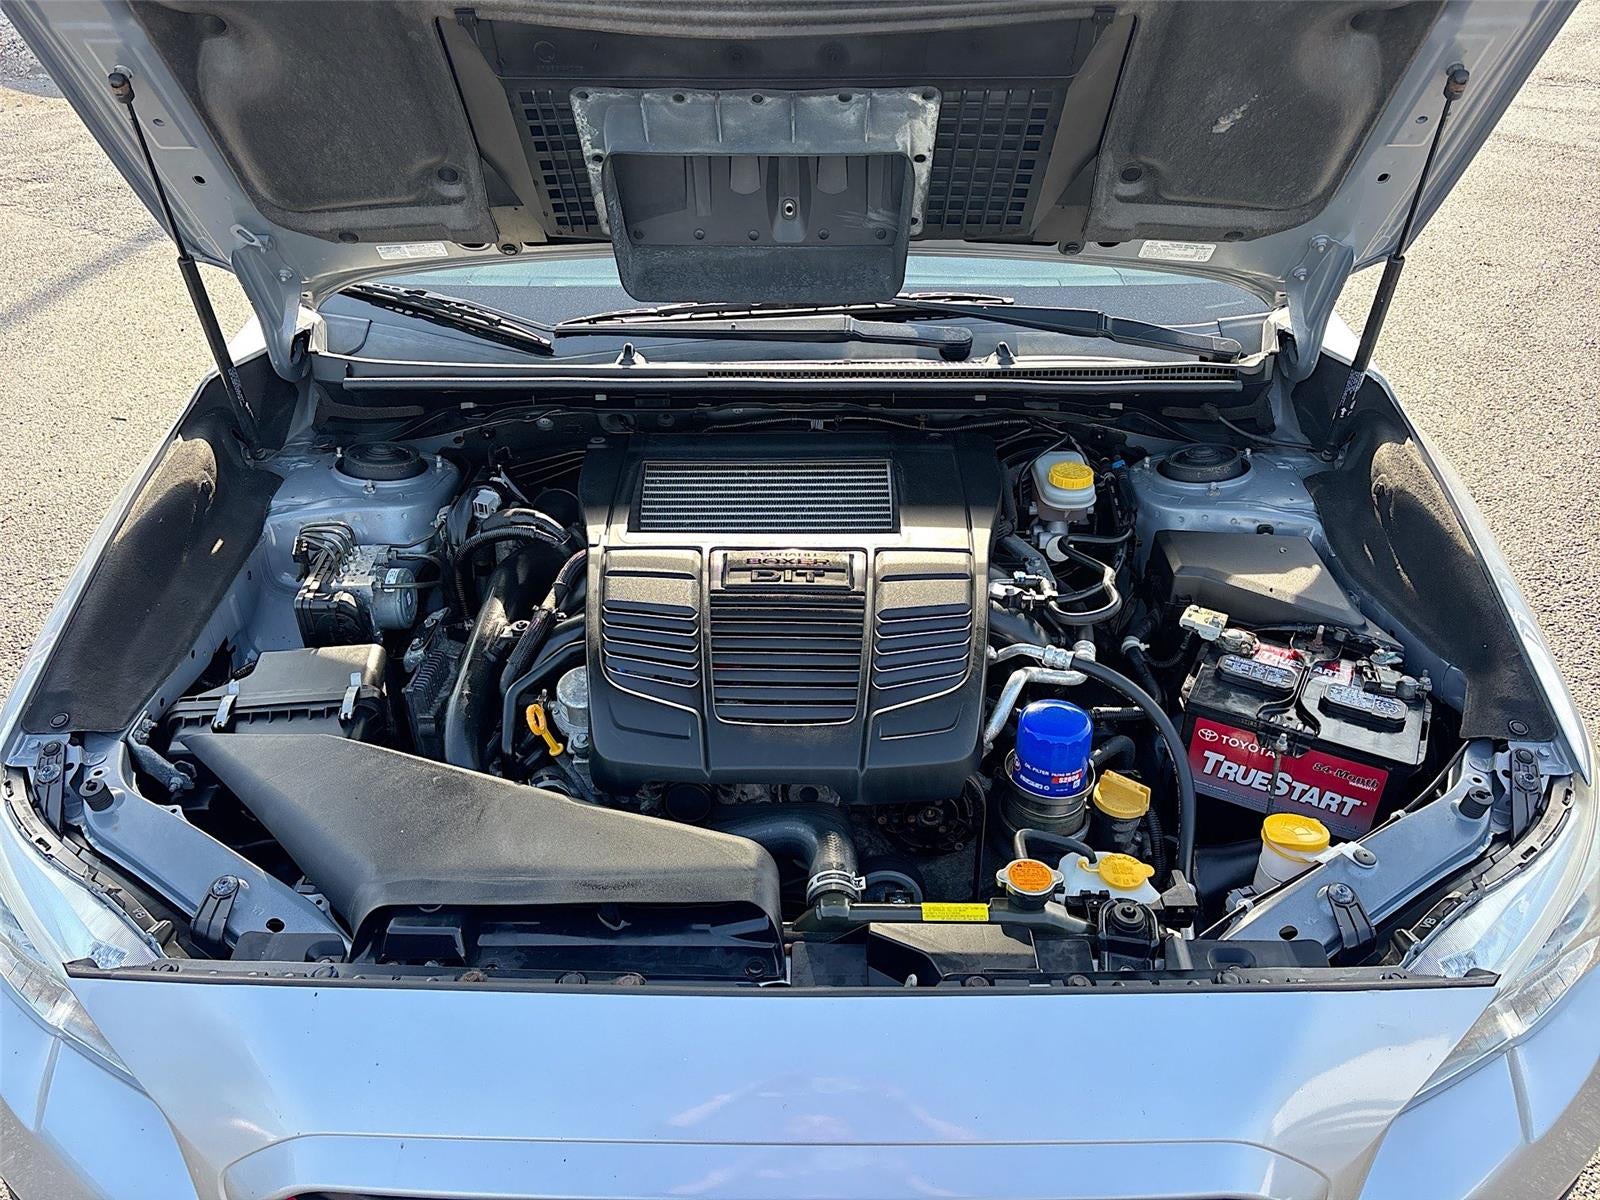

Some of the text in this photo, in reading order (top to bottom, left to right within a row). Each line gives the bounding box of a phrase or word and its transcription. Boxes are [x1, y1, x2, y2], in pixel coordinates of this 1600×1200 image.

[746, 558, 831, 566] BOXER
[751, 569, 825, 583] DIT
[1221, 734, 1276, 759] TOYOTA
[1032, 767, 1050, 776] FILTER
